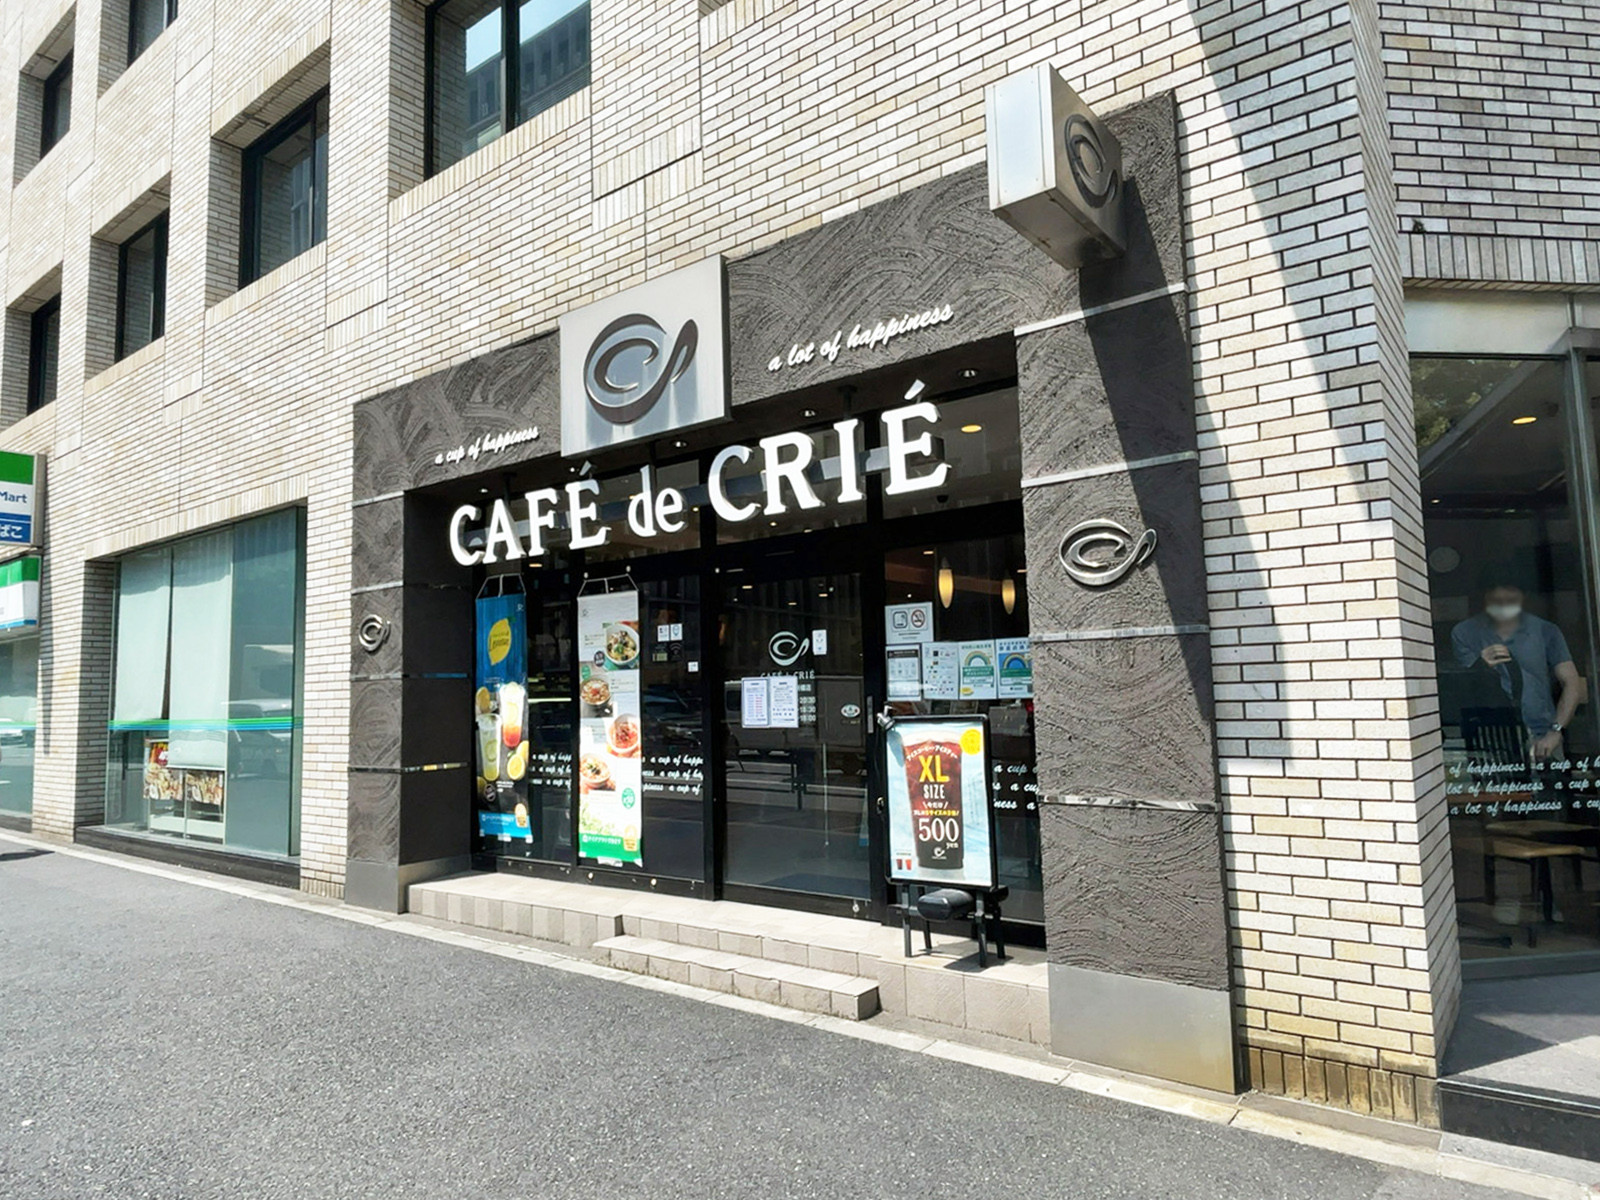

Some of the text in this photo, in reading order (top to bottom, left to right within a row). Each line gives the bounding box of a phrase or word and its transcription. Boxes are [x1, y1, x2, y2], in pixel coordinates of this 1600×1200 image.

[768, 304, 954, 371] a lot of happiness
[434, 426, 539, 465] a cup of happiness
[448, 379, 953, 567] CAFÉ de CRIÉ
[918, 754, 950, 783] XL
[994, 764, 1003, 773] a
[1007, 763, 1028, 776] cup
[1449, 761, 1461, 777] of
[1466, 760, 1526, 776] happiness
[1536, 762, 1545, 770] a
[1550, 759, 1571, 772] cup
[1576, 757, 1589, 772] of
[923, 784, 945, 799] SIZE
[1010, 783, 1019, 791] a
[1446, 783, 1463, 795] lot
[1468, 781, 1481, 797] of
[1485, 780, 1545, 795] happiness
[1554, 781, 1563, 789] a
[1568, 780, 1590, 791] cup
[1026, 802, 1036, 811] a
[1450, 806, 1459, 815] a
[1464, 802, 1481, 814] lot
[1487, 800, 1499, 816] of
[1503, 799, 1562, 814] happiness
[1572, 800, 1582, 809] a
[918, 817, 960, 842] 500
